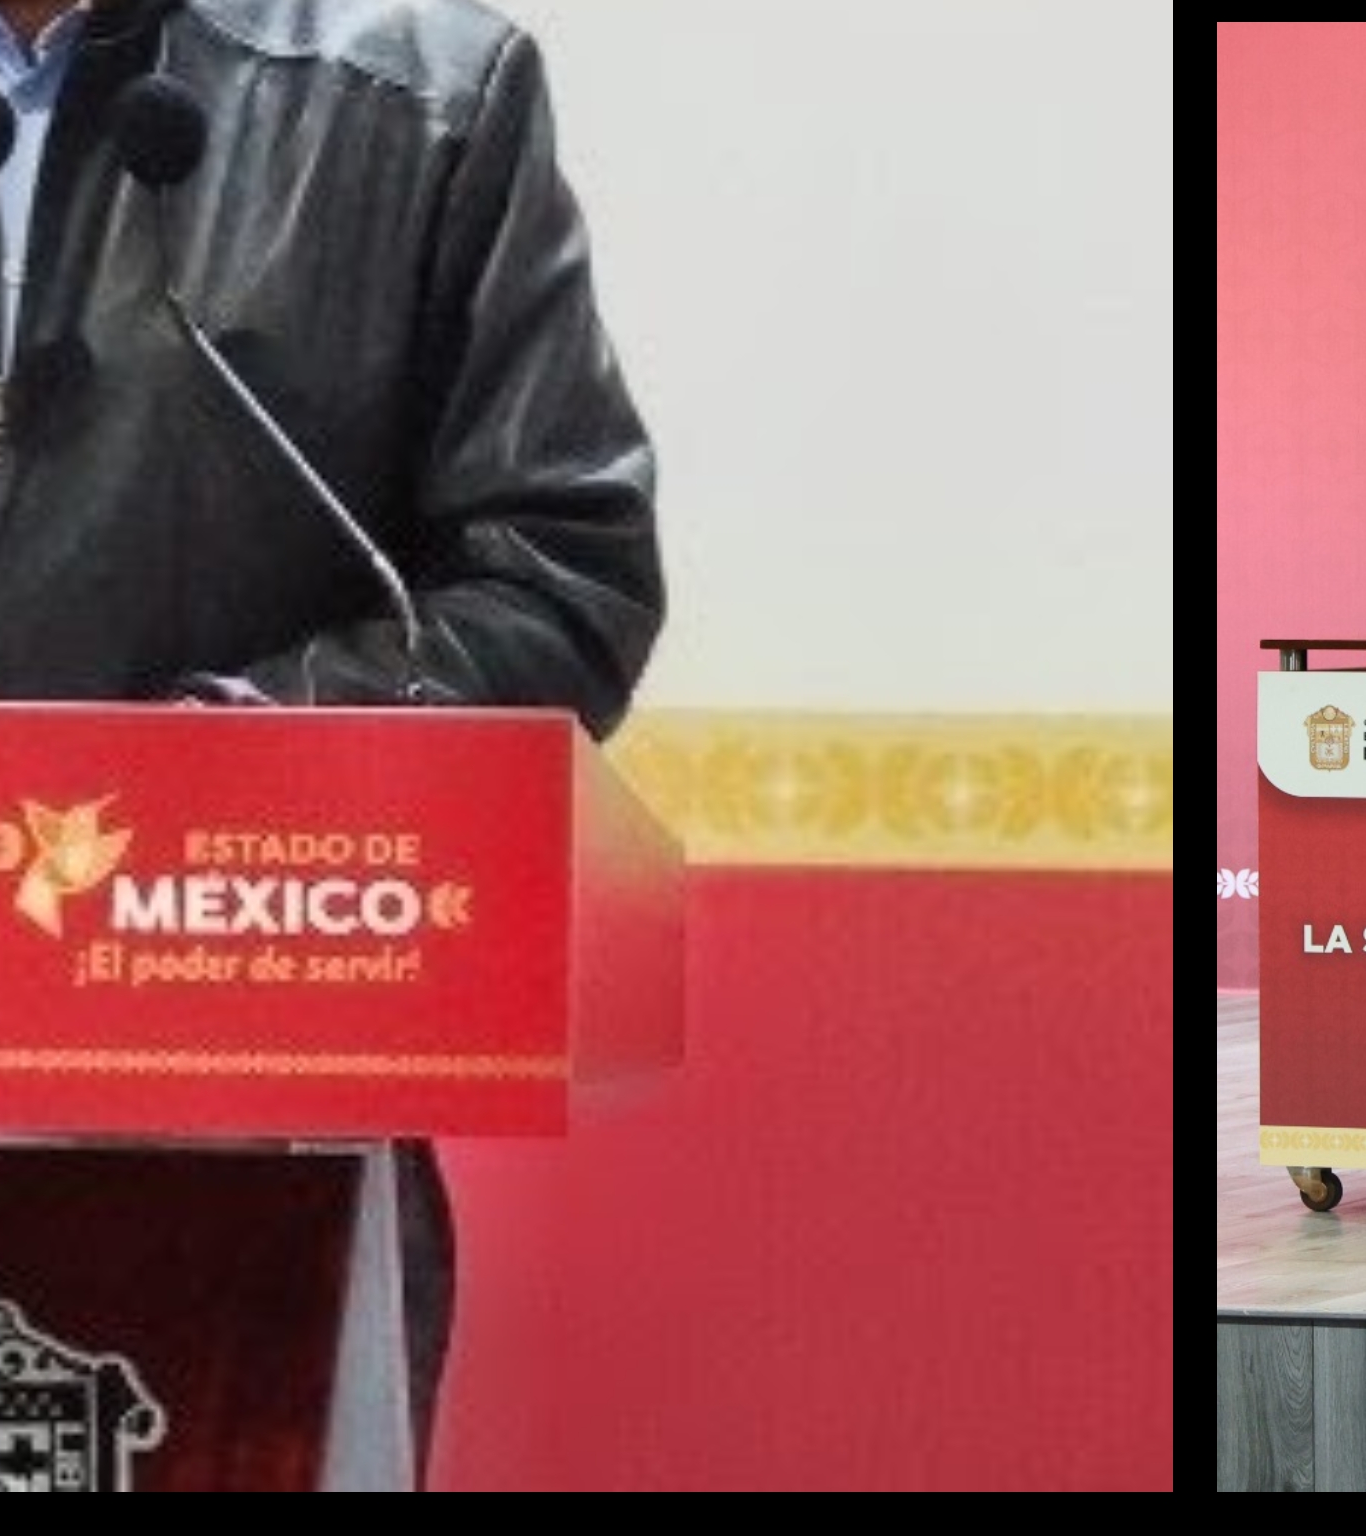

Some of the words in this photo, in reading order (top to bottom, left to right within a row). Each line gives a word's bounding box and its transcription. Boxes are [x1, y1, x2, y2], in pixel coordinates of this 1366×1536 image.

[185, 831, 355, 865] ESTADO
[365, 833, 421, 865] DE
[110, 868, 422, 936] MÉXICO
[1303, 924, 1352, 954] LA
[74, 940, 123, 987] ¡El
[132, 946, 241, 987] poder
[249, 946, 294, 983] de
[303, 947, 422, 983] servir!
